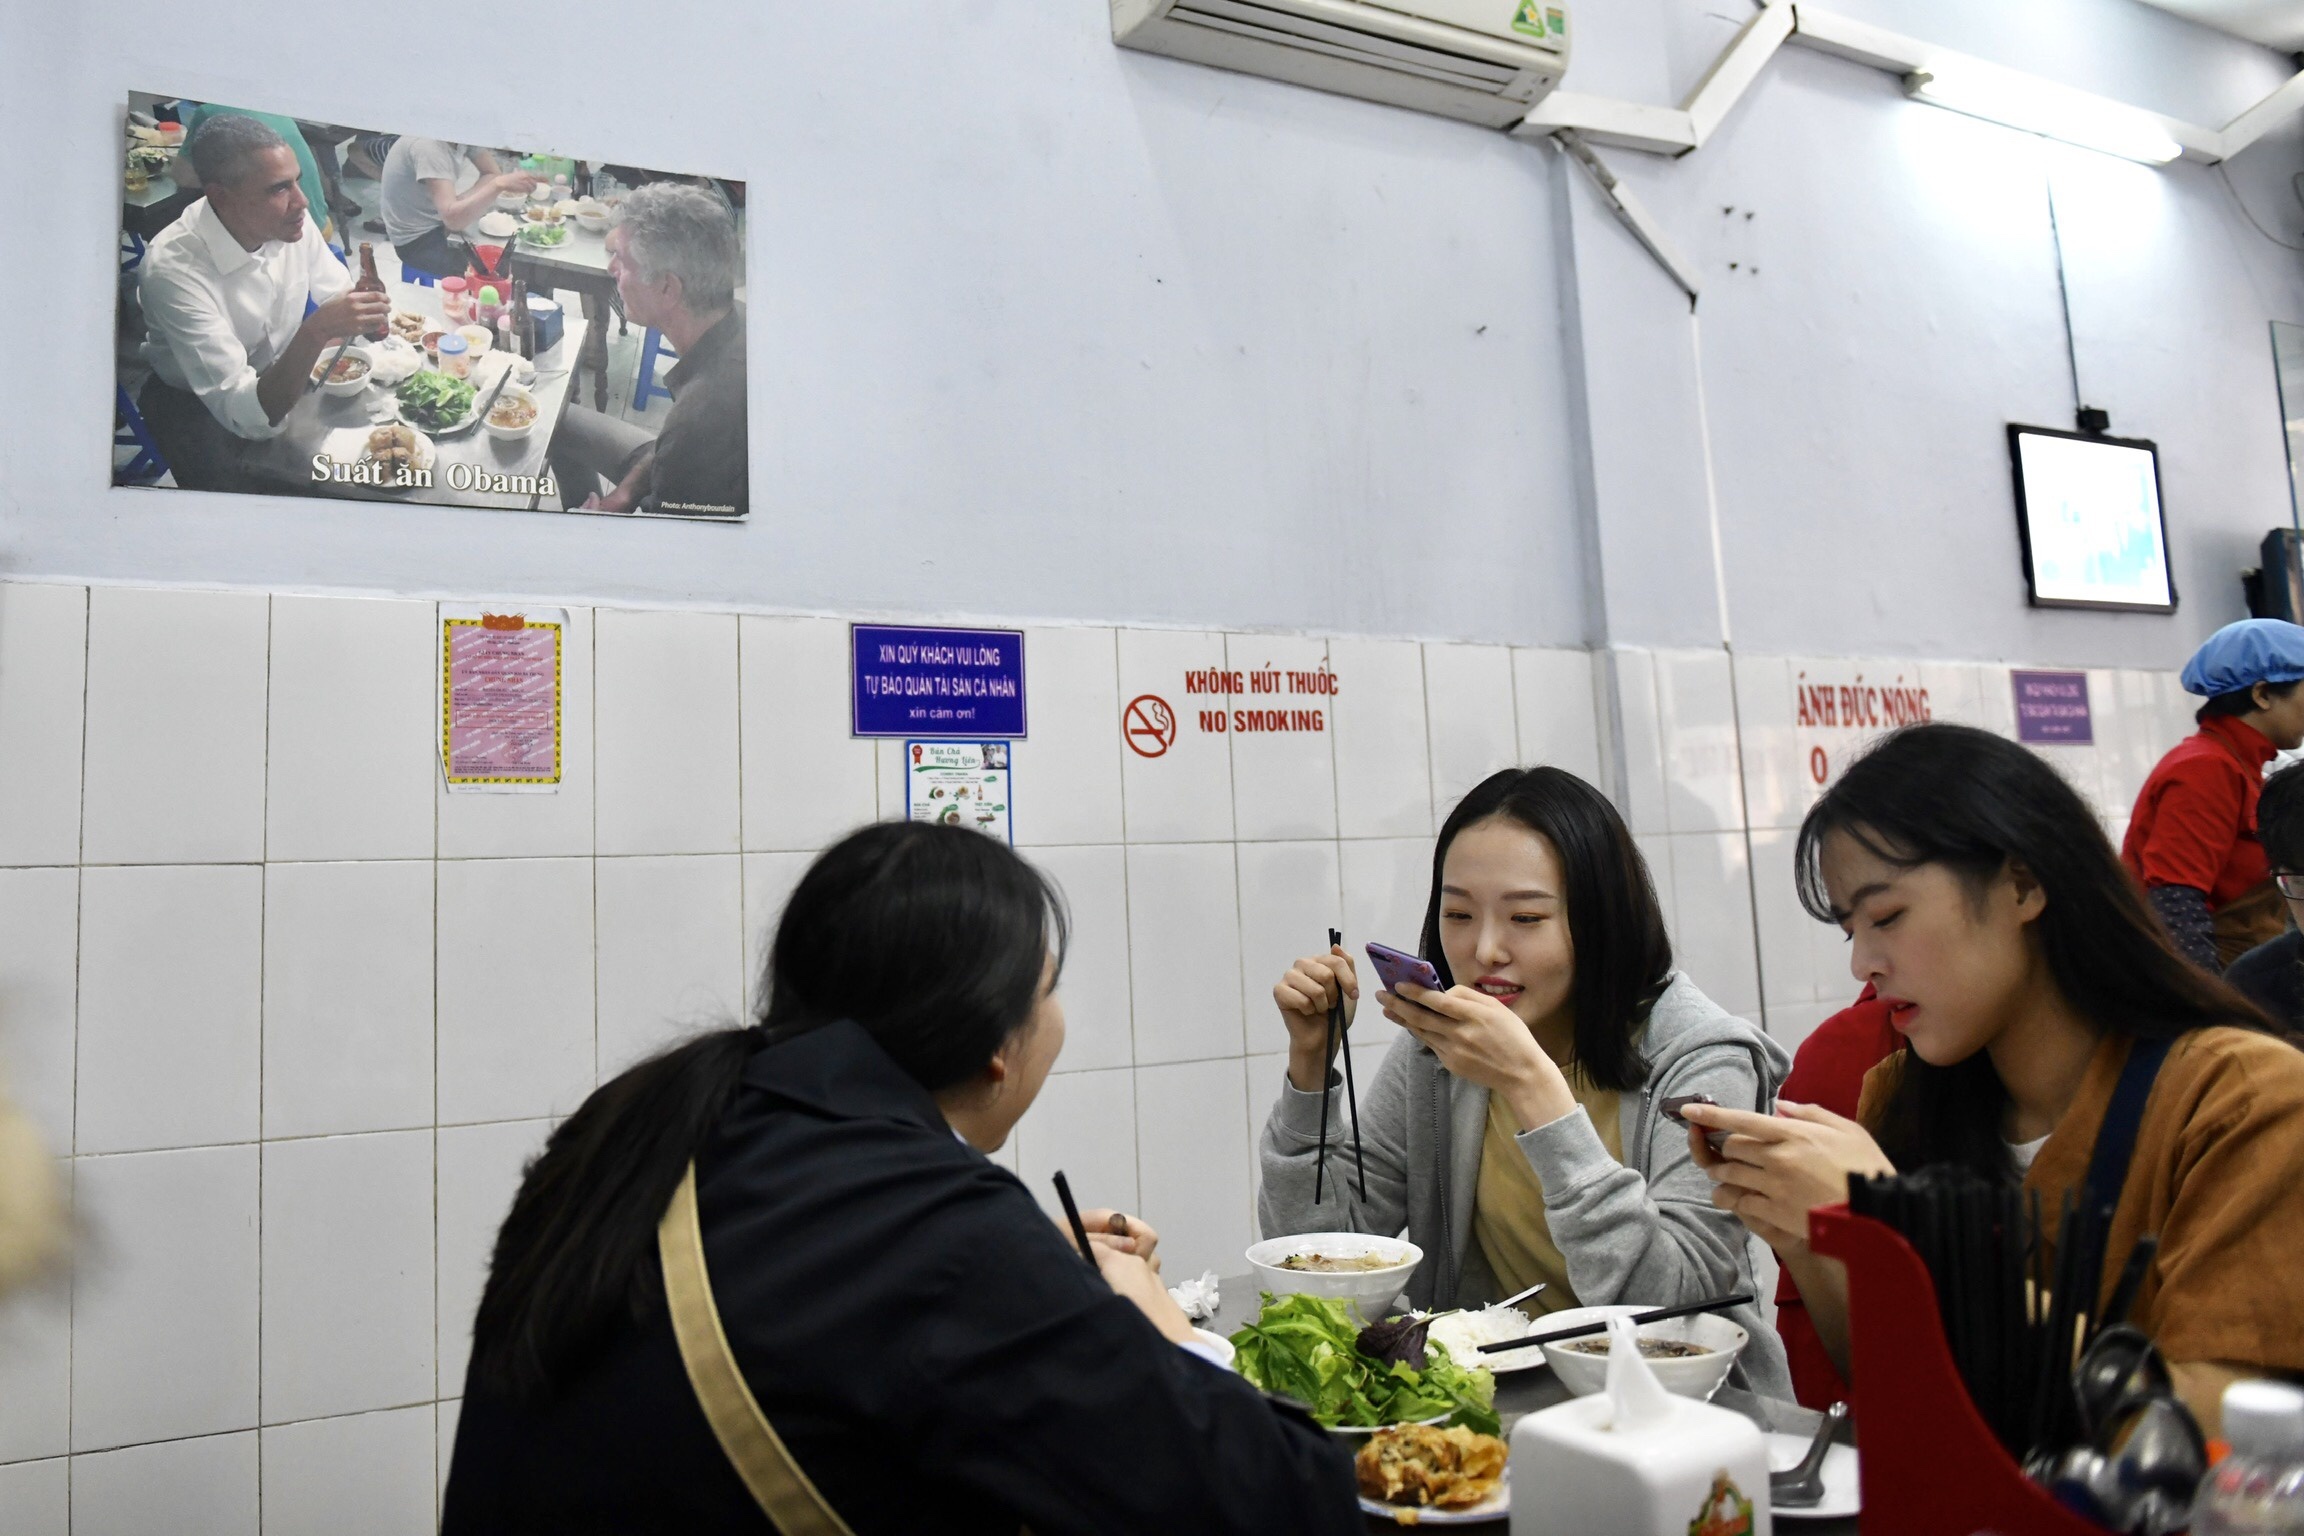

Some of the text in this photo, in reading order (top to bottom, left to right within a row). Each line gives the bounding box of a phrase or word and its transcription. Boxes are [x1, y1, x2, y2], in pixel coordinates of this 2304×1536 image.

[311, 453, 556, 496] Suất ăn Obama
[879, 642, 1000, 666] XIN QUÝ KHÁCH VUI LÒNG
[989, 675, 1016, 698] NHÂN
[1185, 656, 1339, 695] KHÔNG HÚT THUỐC
[909, 707, 926, 718] xin
[1199, 710, 1324, 733] NO SMOKING
